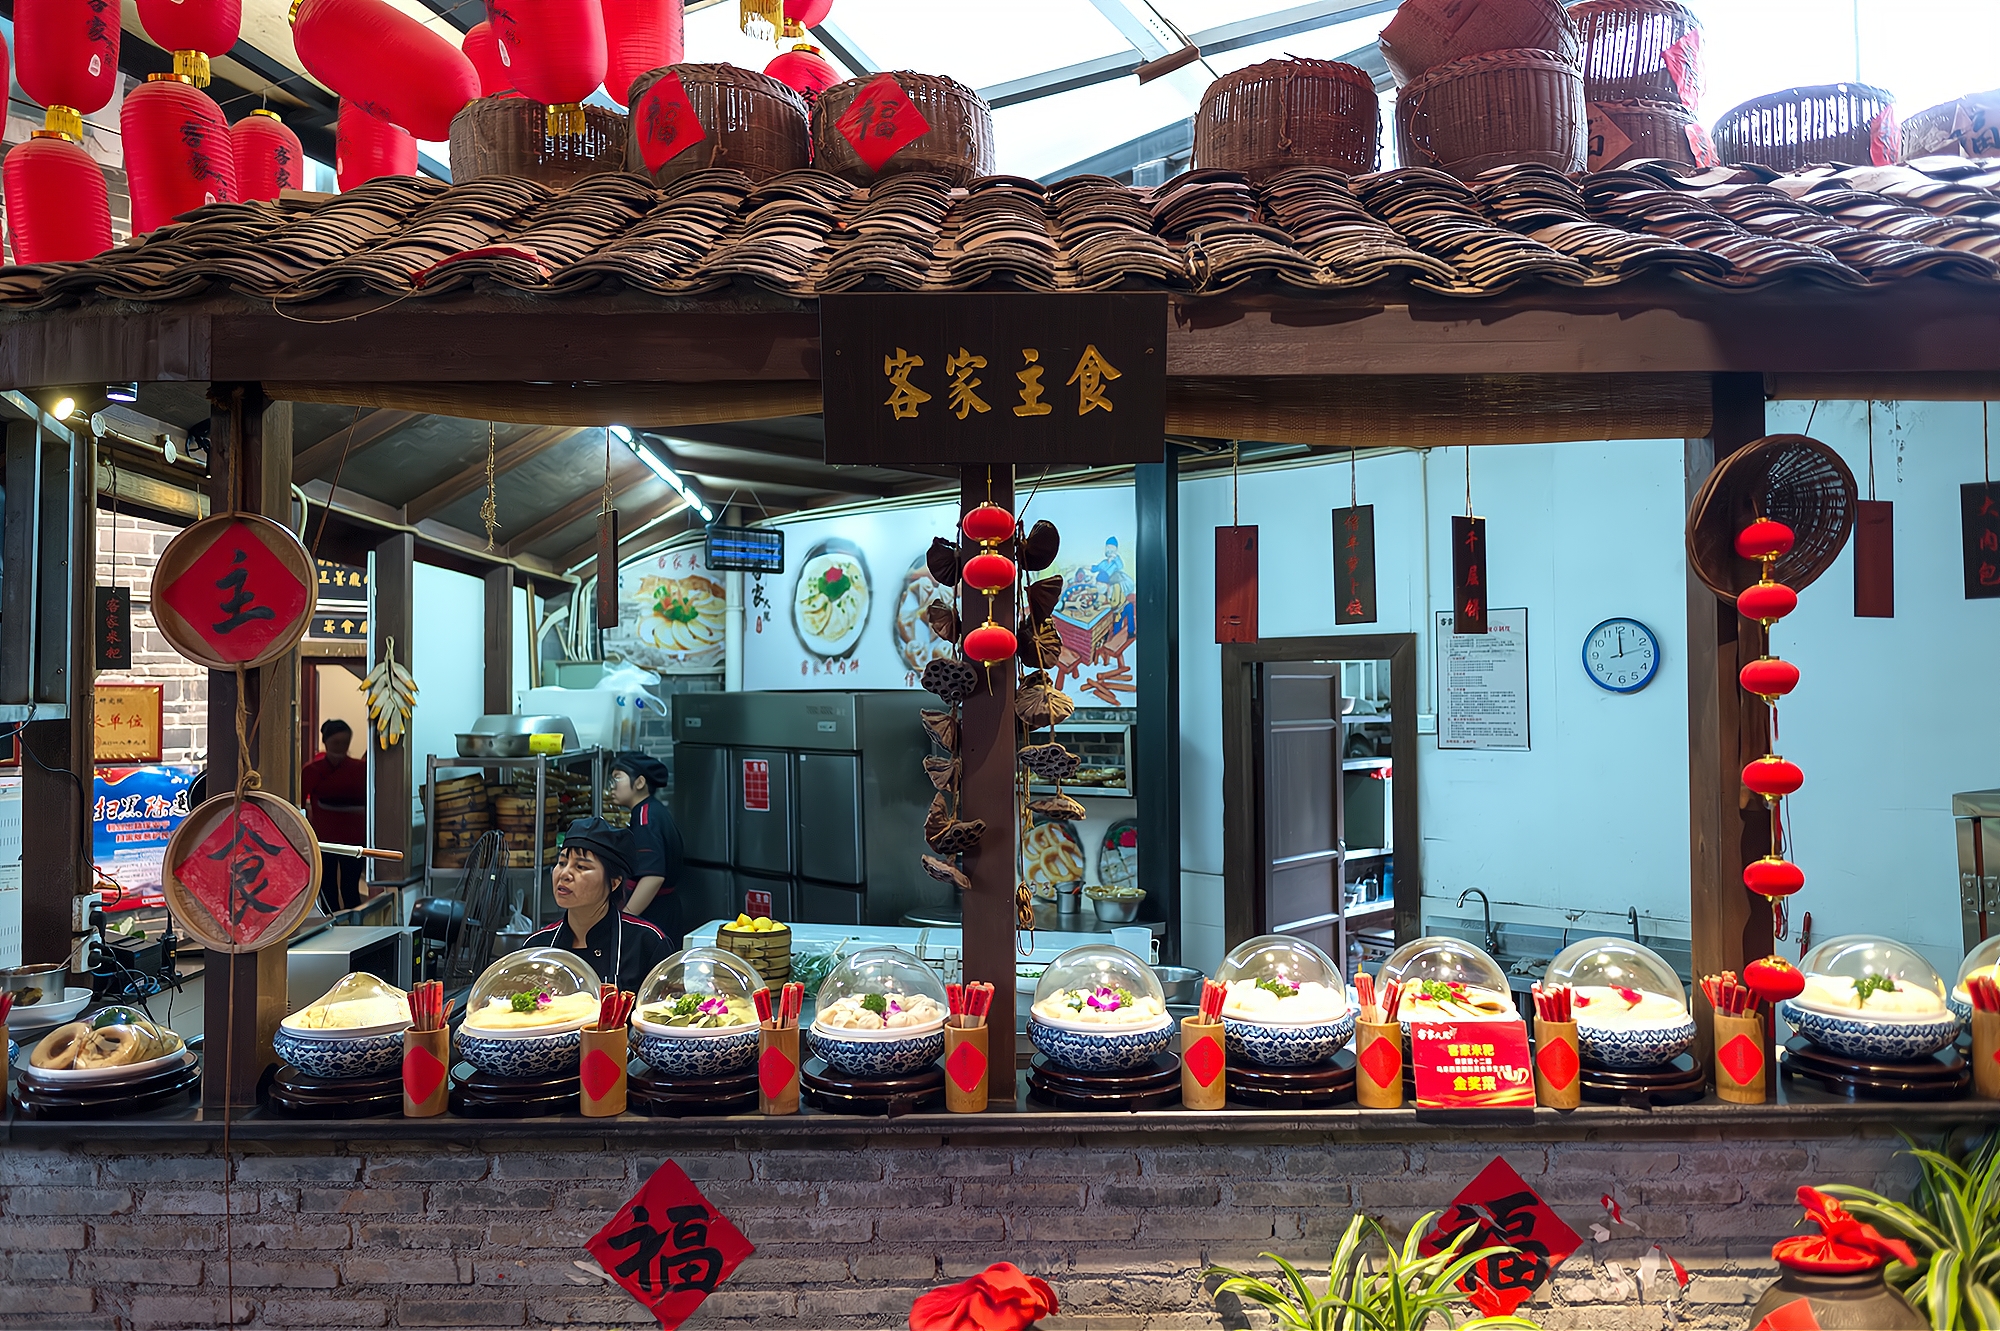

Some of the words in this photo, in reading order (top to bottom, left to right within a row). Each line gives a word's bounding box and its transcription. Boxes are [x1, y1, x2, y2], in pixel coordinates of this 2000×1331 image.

[646, 97, 683, 147] 福
[857, 98, 899, 140] 福
[884, 344, 1122, 420] 客家主食
[1464, 530, 1481, 622] 千层饼
[212, 549, 275, 634] 主
[1603, 629, 1611, 638] 11
[1615, 626, 1625, 634] 12
[1631, 629, 1635, 637] 1
[1594, 639, 1604, 648] 10
[1639, 637, 1647, 646] 2
[1591, 651, 1599, 660] 9
[1643, 649, 1651, 658] 3
[1596, 663, 1604, 671] 8
[1640, 662, 1647, 670] 4
[1606, 672, 1612, 681] 7
[1618, 675, 1626, 684] 6
[1631, 671, 1639, 680] 5
[207, 822, 286, 925] 食
[1447, 1044, 1495, 1057] 客家米粑
[1453, 1076, 1497, 1091] 金奖菜
[1431, 1191, 1551, 1293] 福
[608, 1205, 724, 1294] 福
